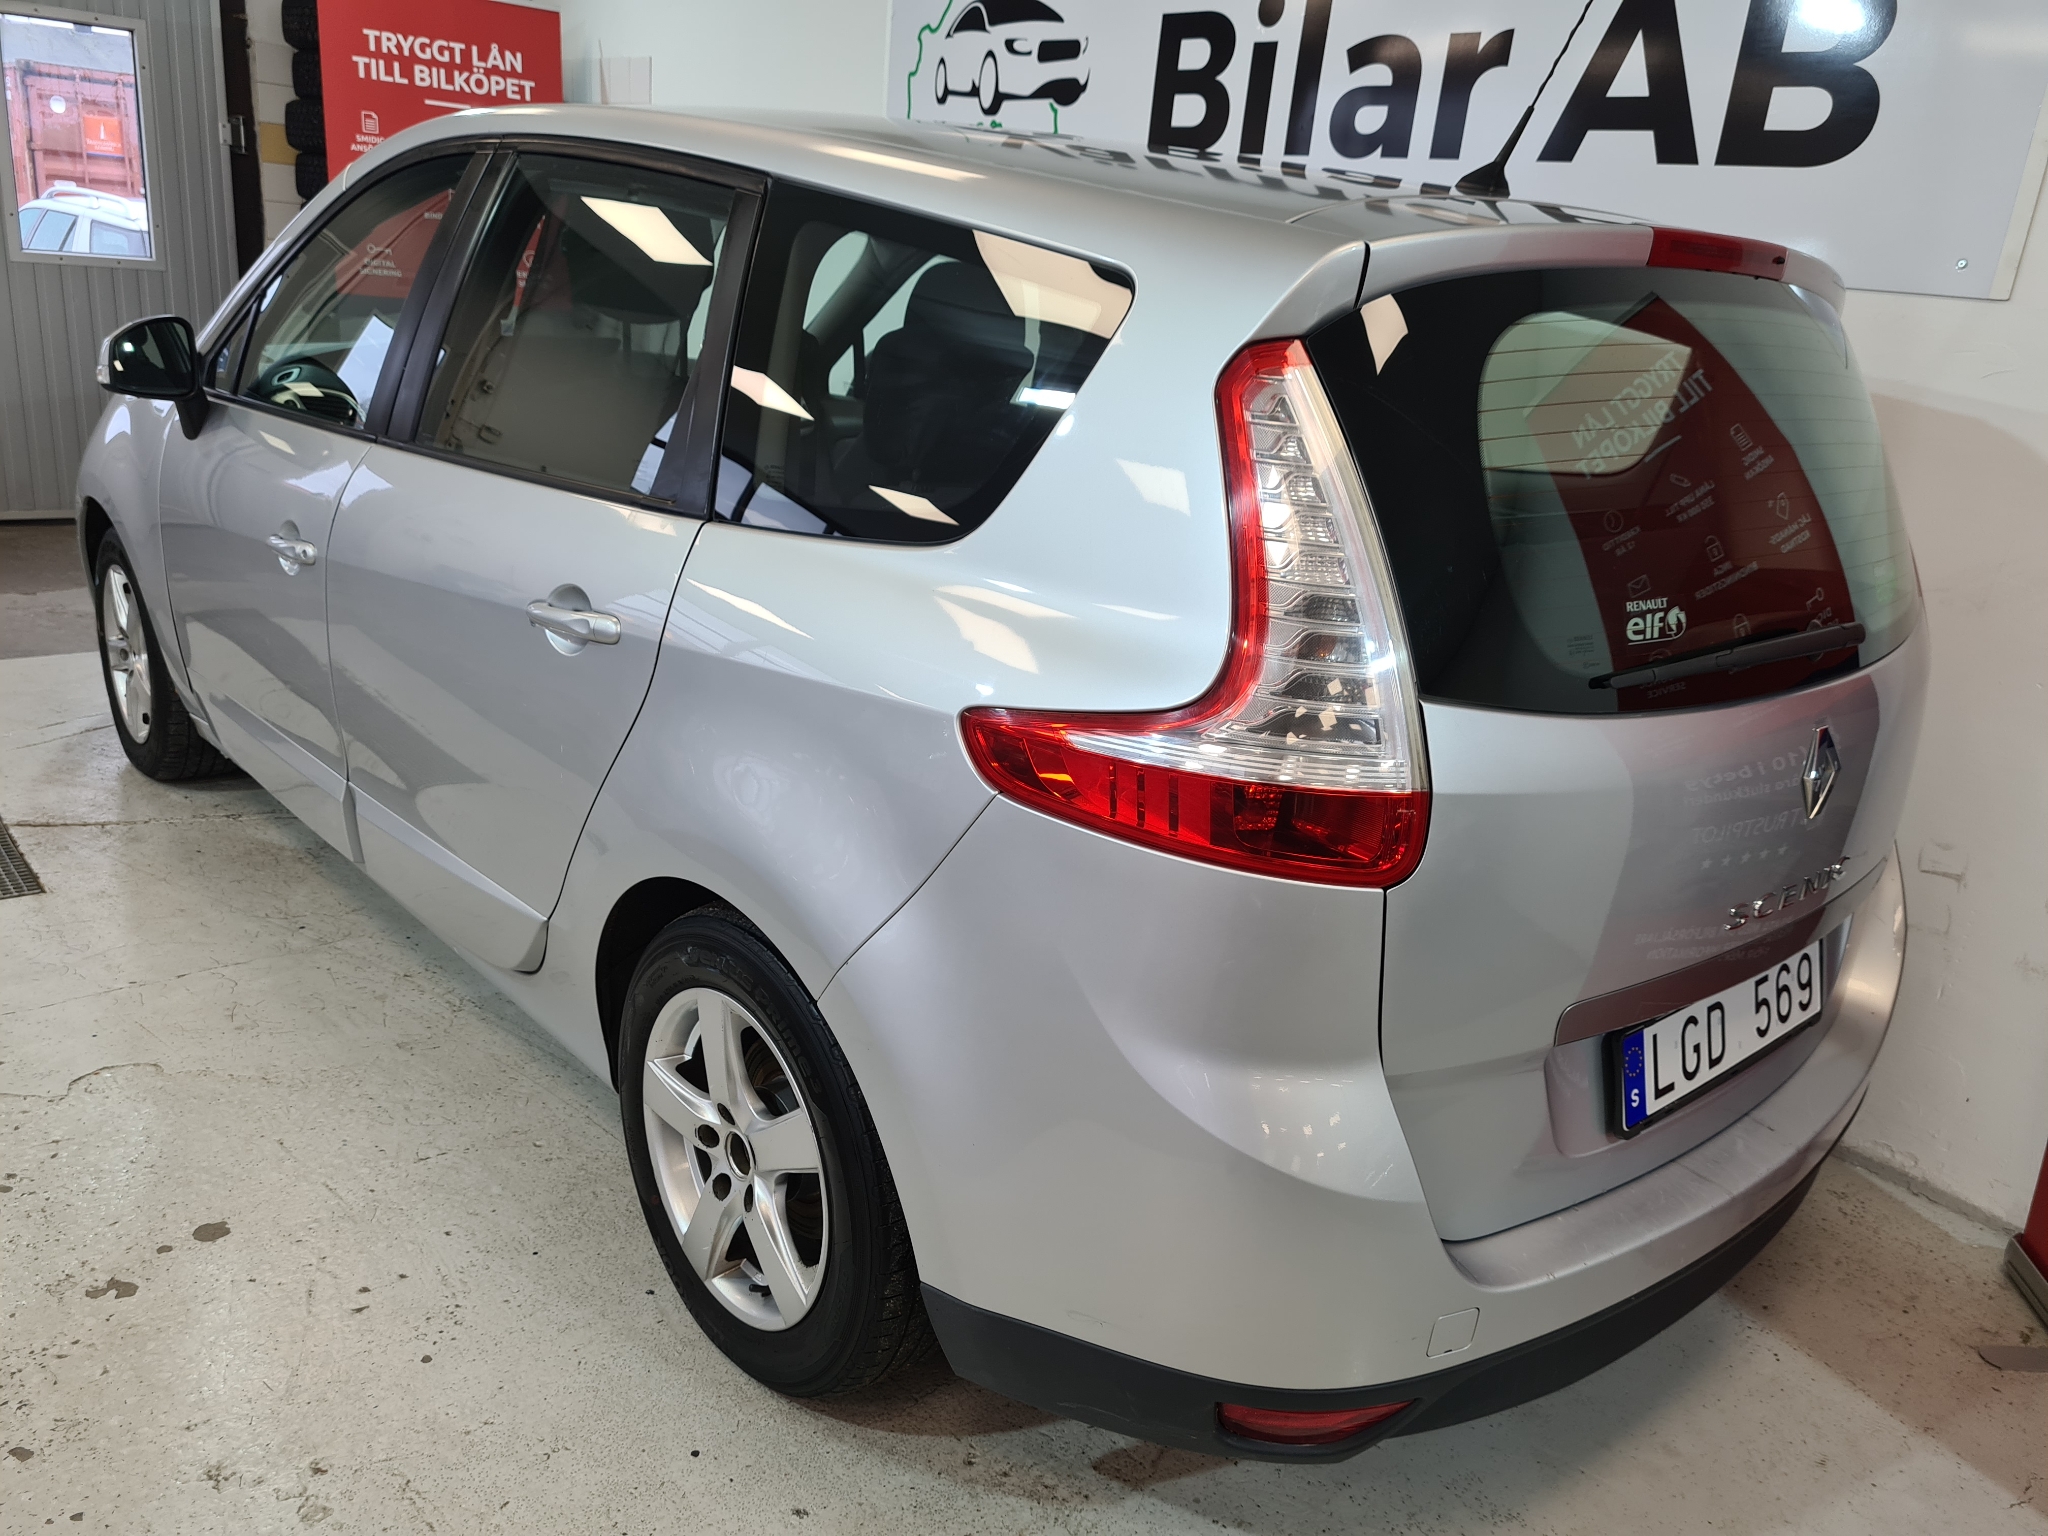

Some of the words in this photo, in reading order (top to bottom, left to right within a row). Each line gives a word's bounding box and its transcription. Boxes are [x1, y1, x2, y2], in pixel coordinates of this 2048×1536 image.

[362, 28, 465, 65] TRYGGT
[471, 42, 523, 74] LÅN
[352, 55, 409, 85] TILL
[414, 64, 536, 102] BILKÖPET
[1149, 0, 1515, 161] Bilar
[1537, 0, 1897, 168] AB
[359, 268, 403, 279] SIGNERING
[364, 257, 396, 269] DIGITAL
[1625, 596, 1669, 612] RENAULT
[1626, 610, 1665, 642] elf
[1652, 1001, 1726, 1101] LGD
[1754, 951, 1814, 1039] 569
[1630, 1088, 1641, 1108] S
